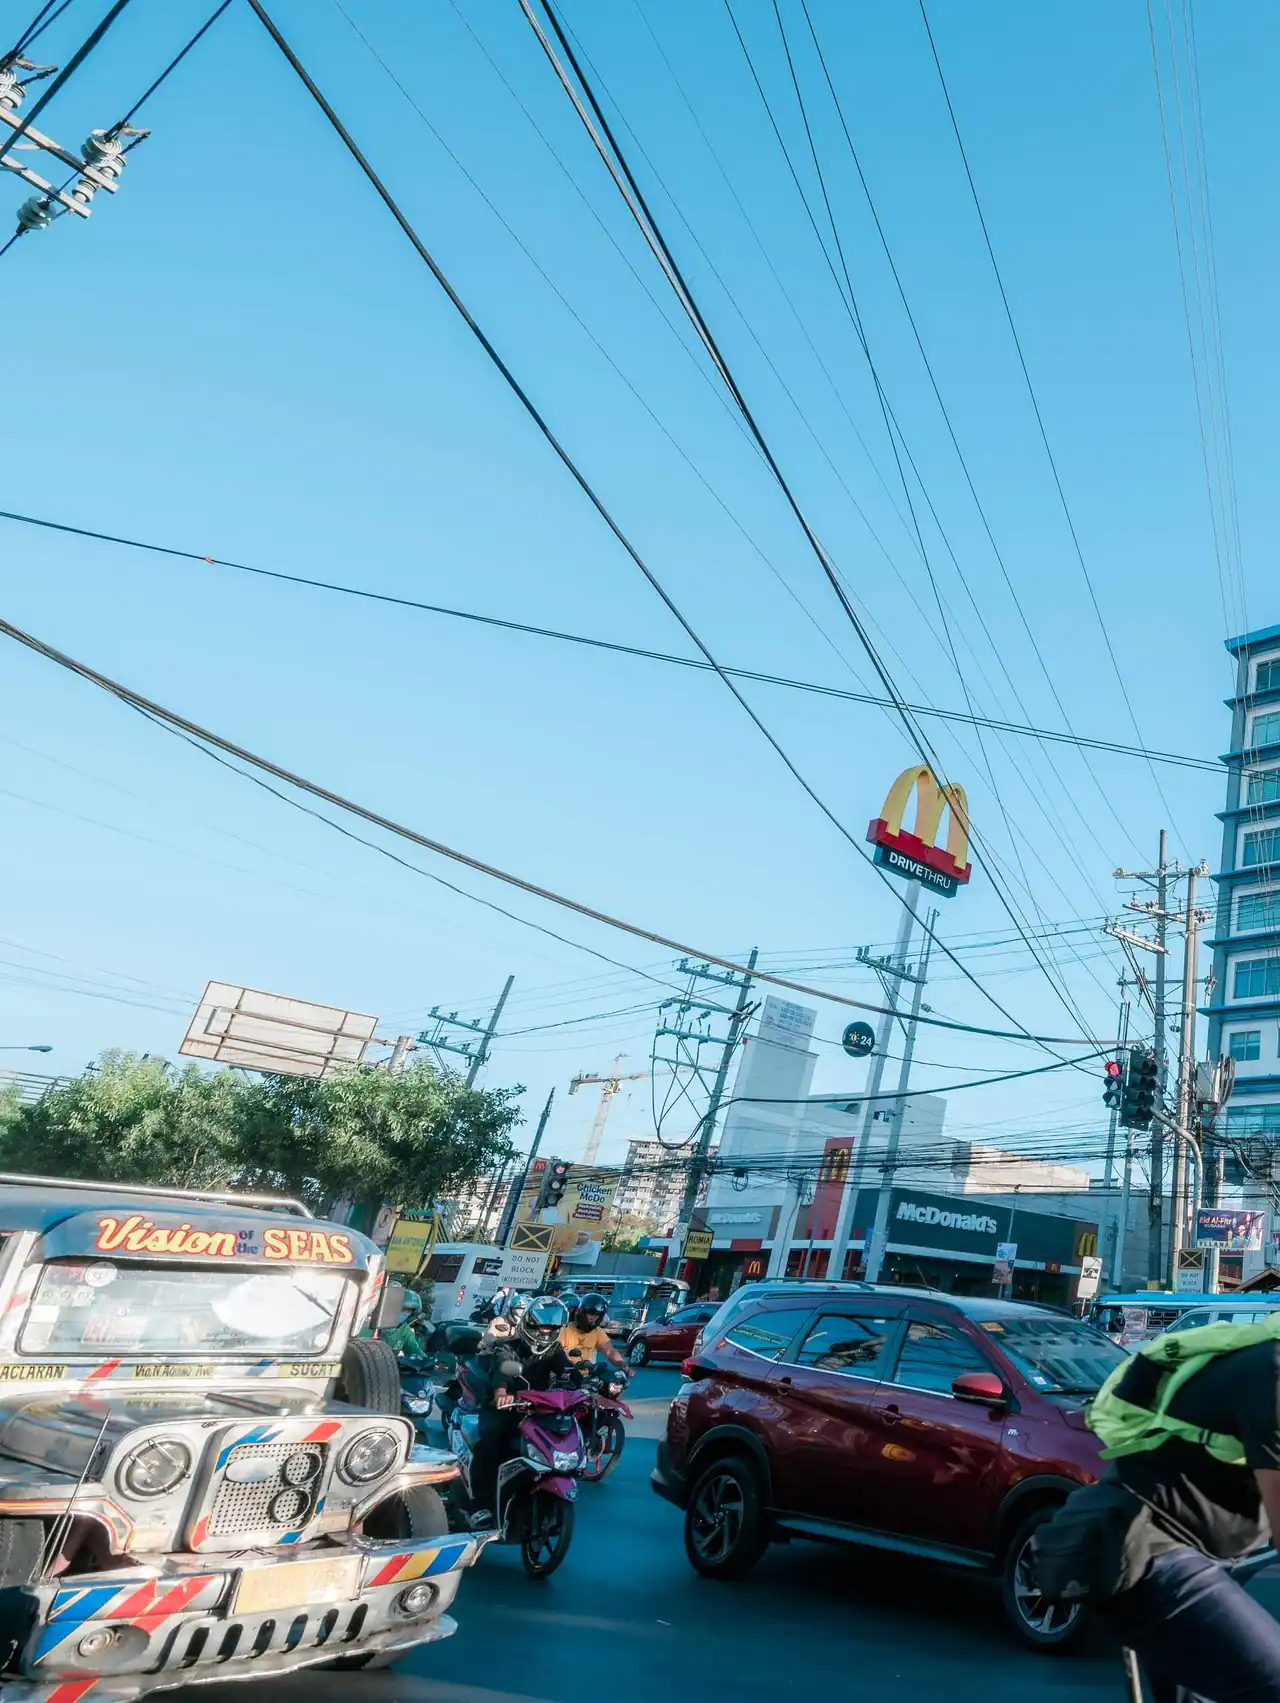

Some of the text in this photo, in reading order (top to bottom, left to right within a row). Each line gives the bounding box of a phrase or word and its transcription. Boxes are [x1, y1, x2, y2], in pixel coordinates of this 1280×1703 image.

[577, 1183, 612, 1195] Chicken
[580, 1192, 605, 1203] McDo
[896, 1202, 998, 1234] McDonald's
[96, 1214, 238, 1258] Vision
[236, 1243, 259, 1255] the
[262, 1228, 354, 1265] SEAS
[512, 1255, 523, 1263] DO
[511, 1265, 535, 1274] BLOCK
[501, 1275, 539, 1285] INTERSECTION
[290, 1363, 335, 1377] SUCAT
